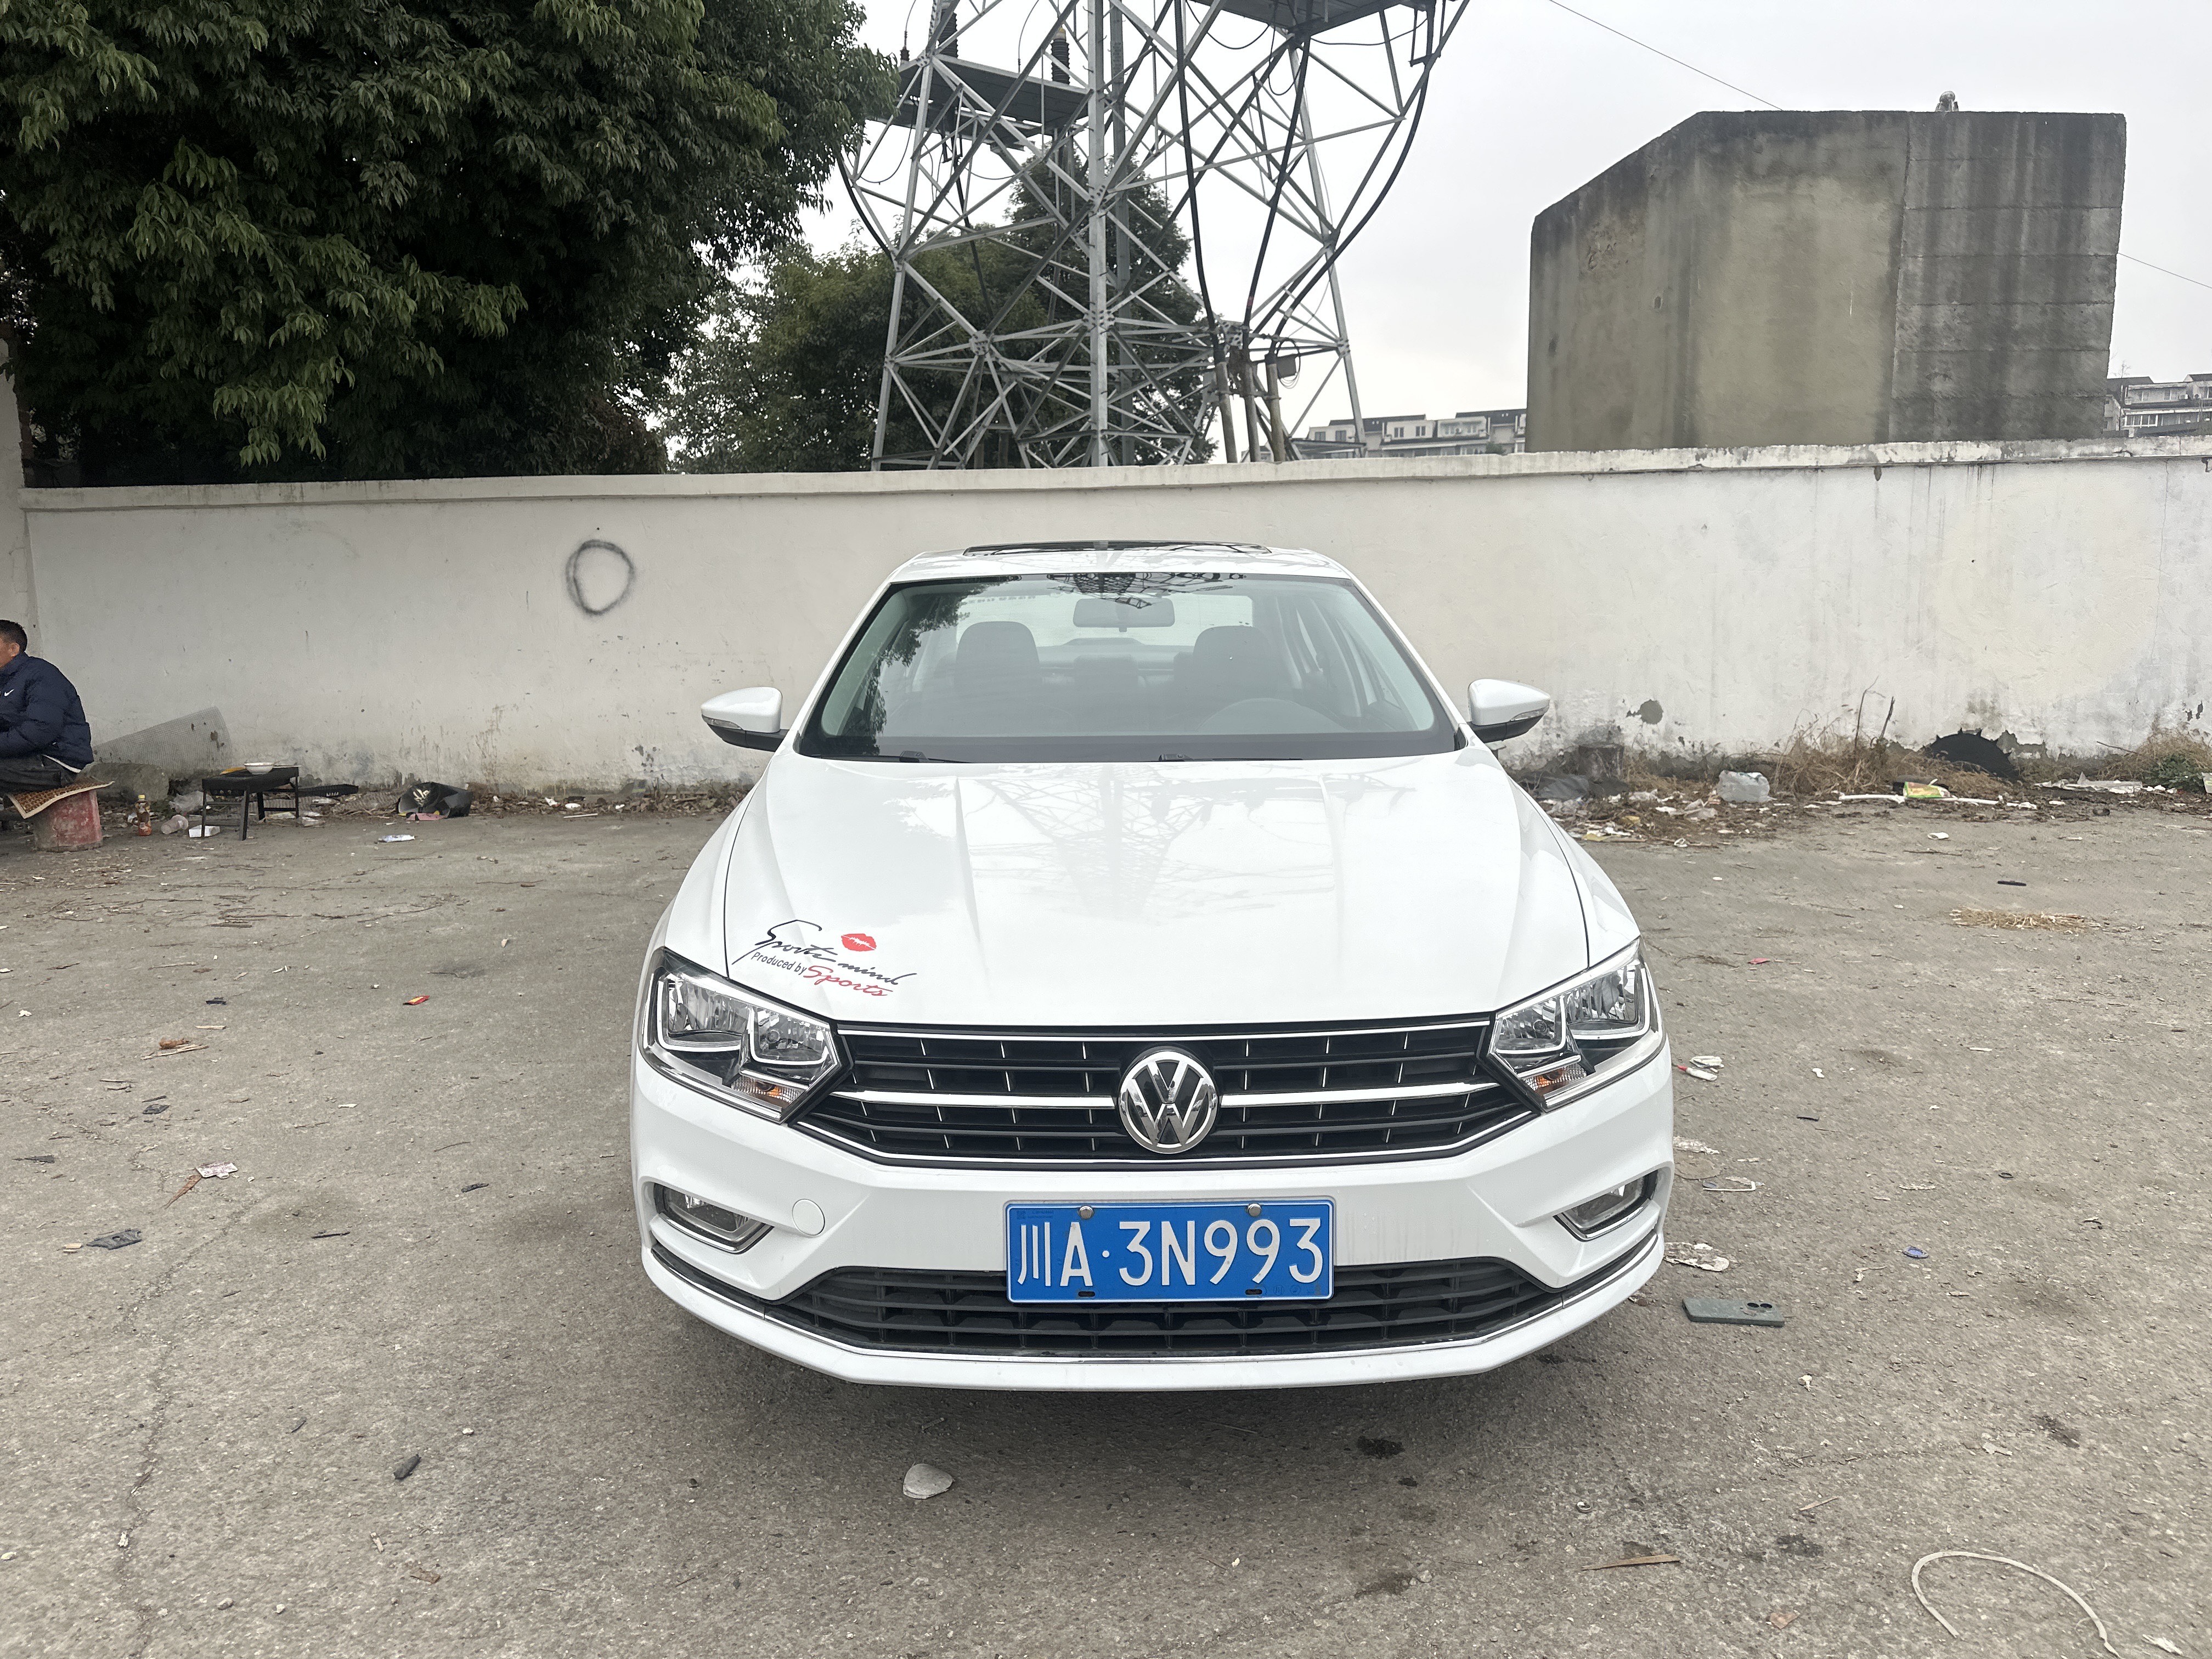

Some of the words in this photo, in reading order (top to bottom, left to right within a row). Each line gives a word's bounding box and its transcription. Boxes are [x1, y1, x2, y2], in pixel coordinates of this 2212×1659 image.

[751, 951, 797, 970] Produced
[793, 962, 808, 975] by
[803, 965, 893, 996] Sports
[838, 962, 917, 985] mind
